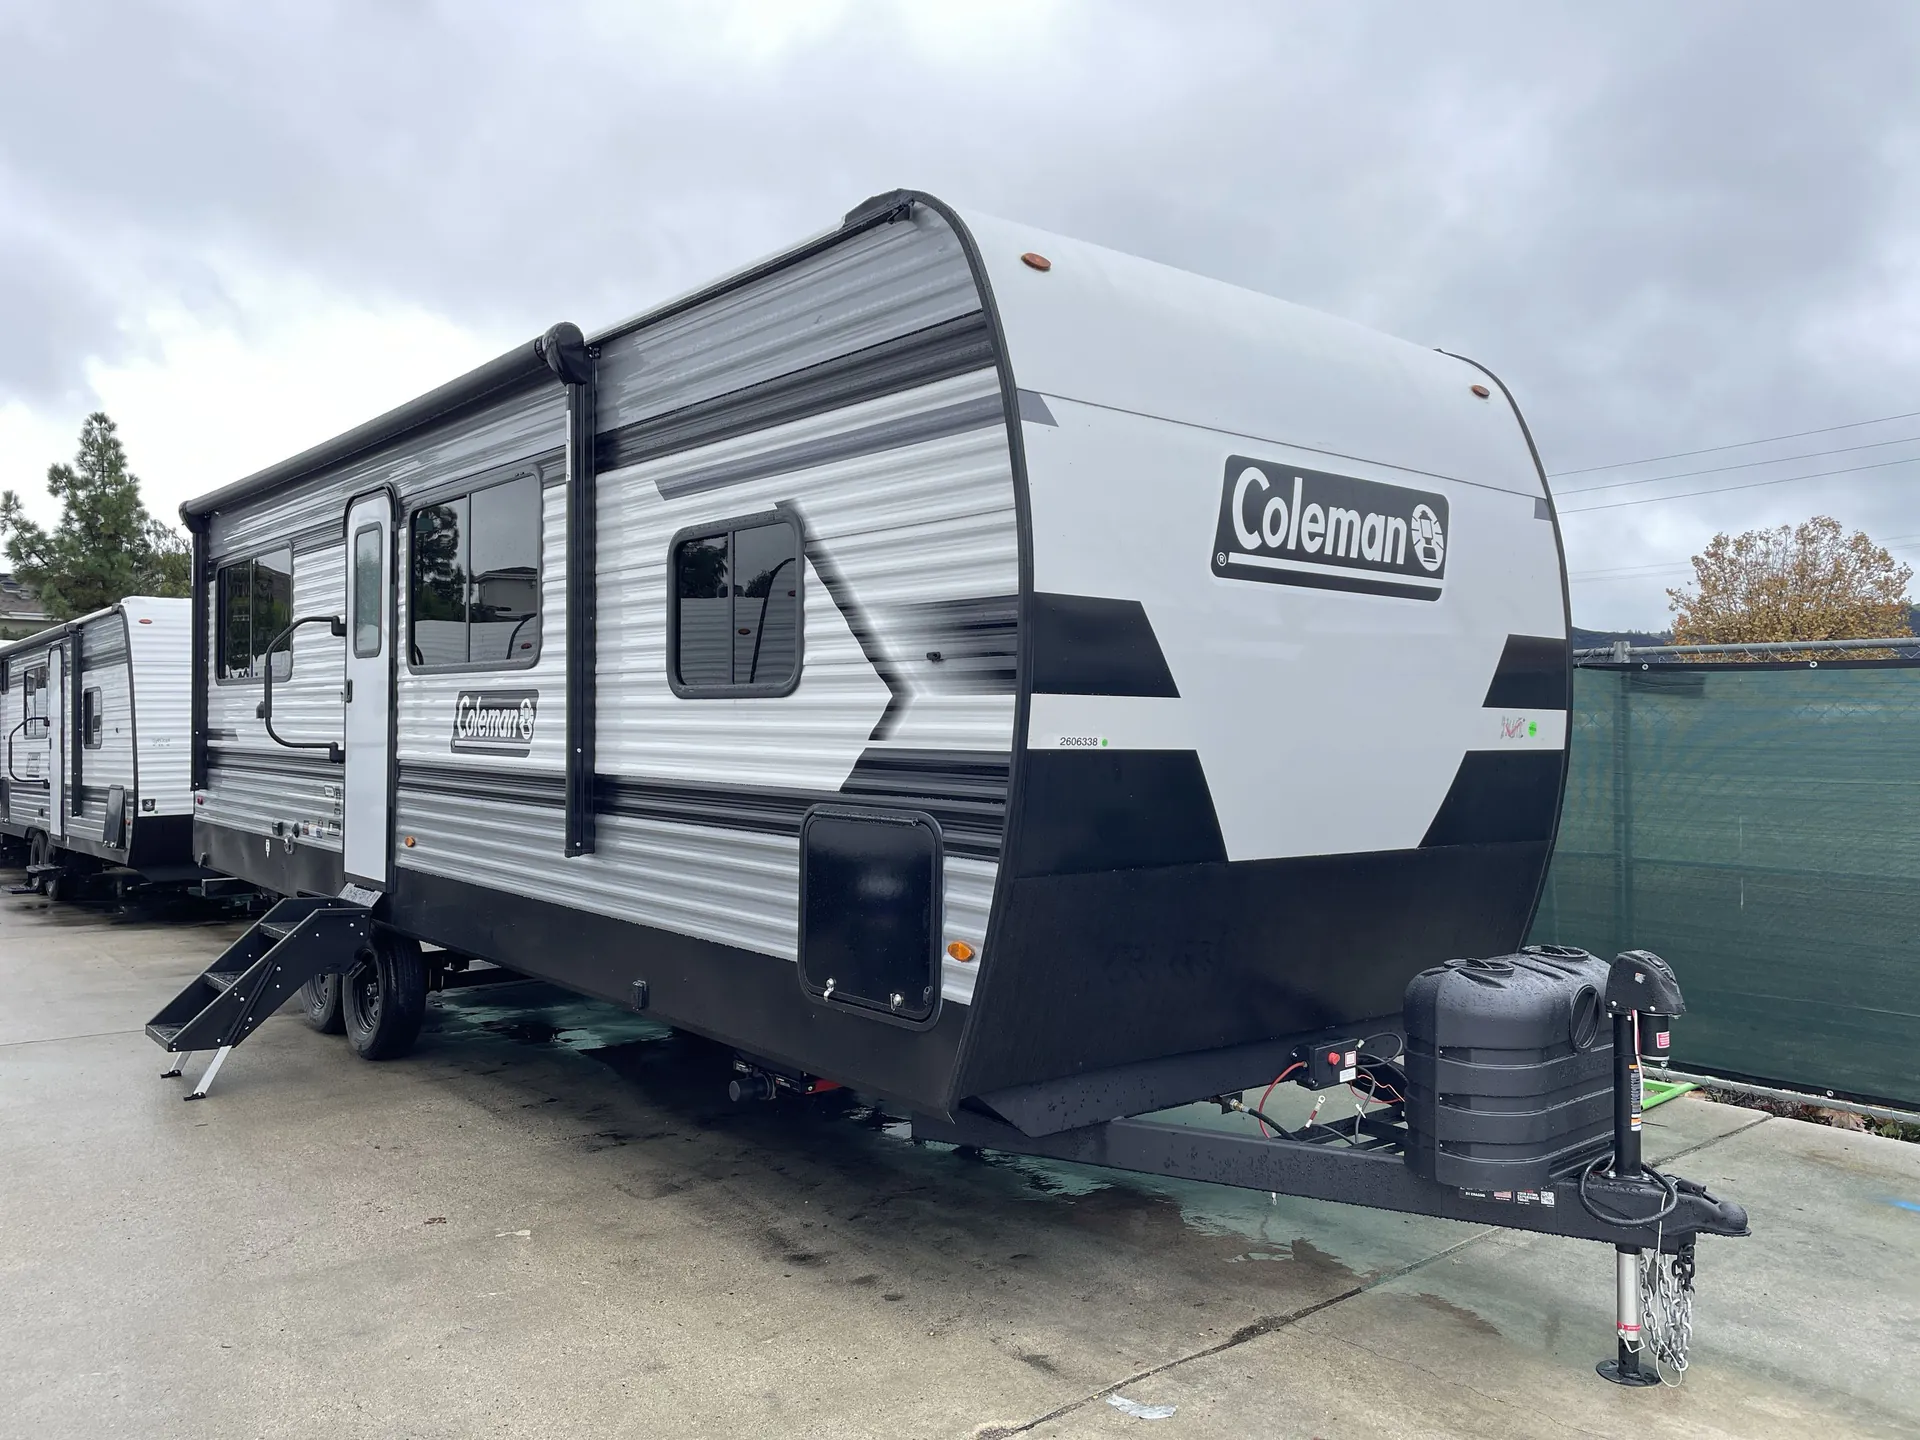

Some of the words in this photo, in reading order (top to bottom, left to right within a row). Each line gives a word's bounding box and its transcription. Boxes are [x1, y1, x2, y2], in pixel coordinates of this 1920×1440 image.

[1232, 466, 1407, 565] Coleman
[458, 695, 519, 738] Coleman
[1060, 737, 1098, 746] 2606338
